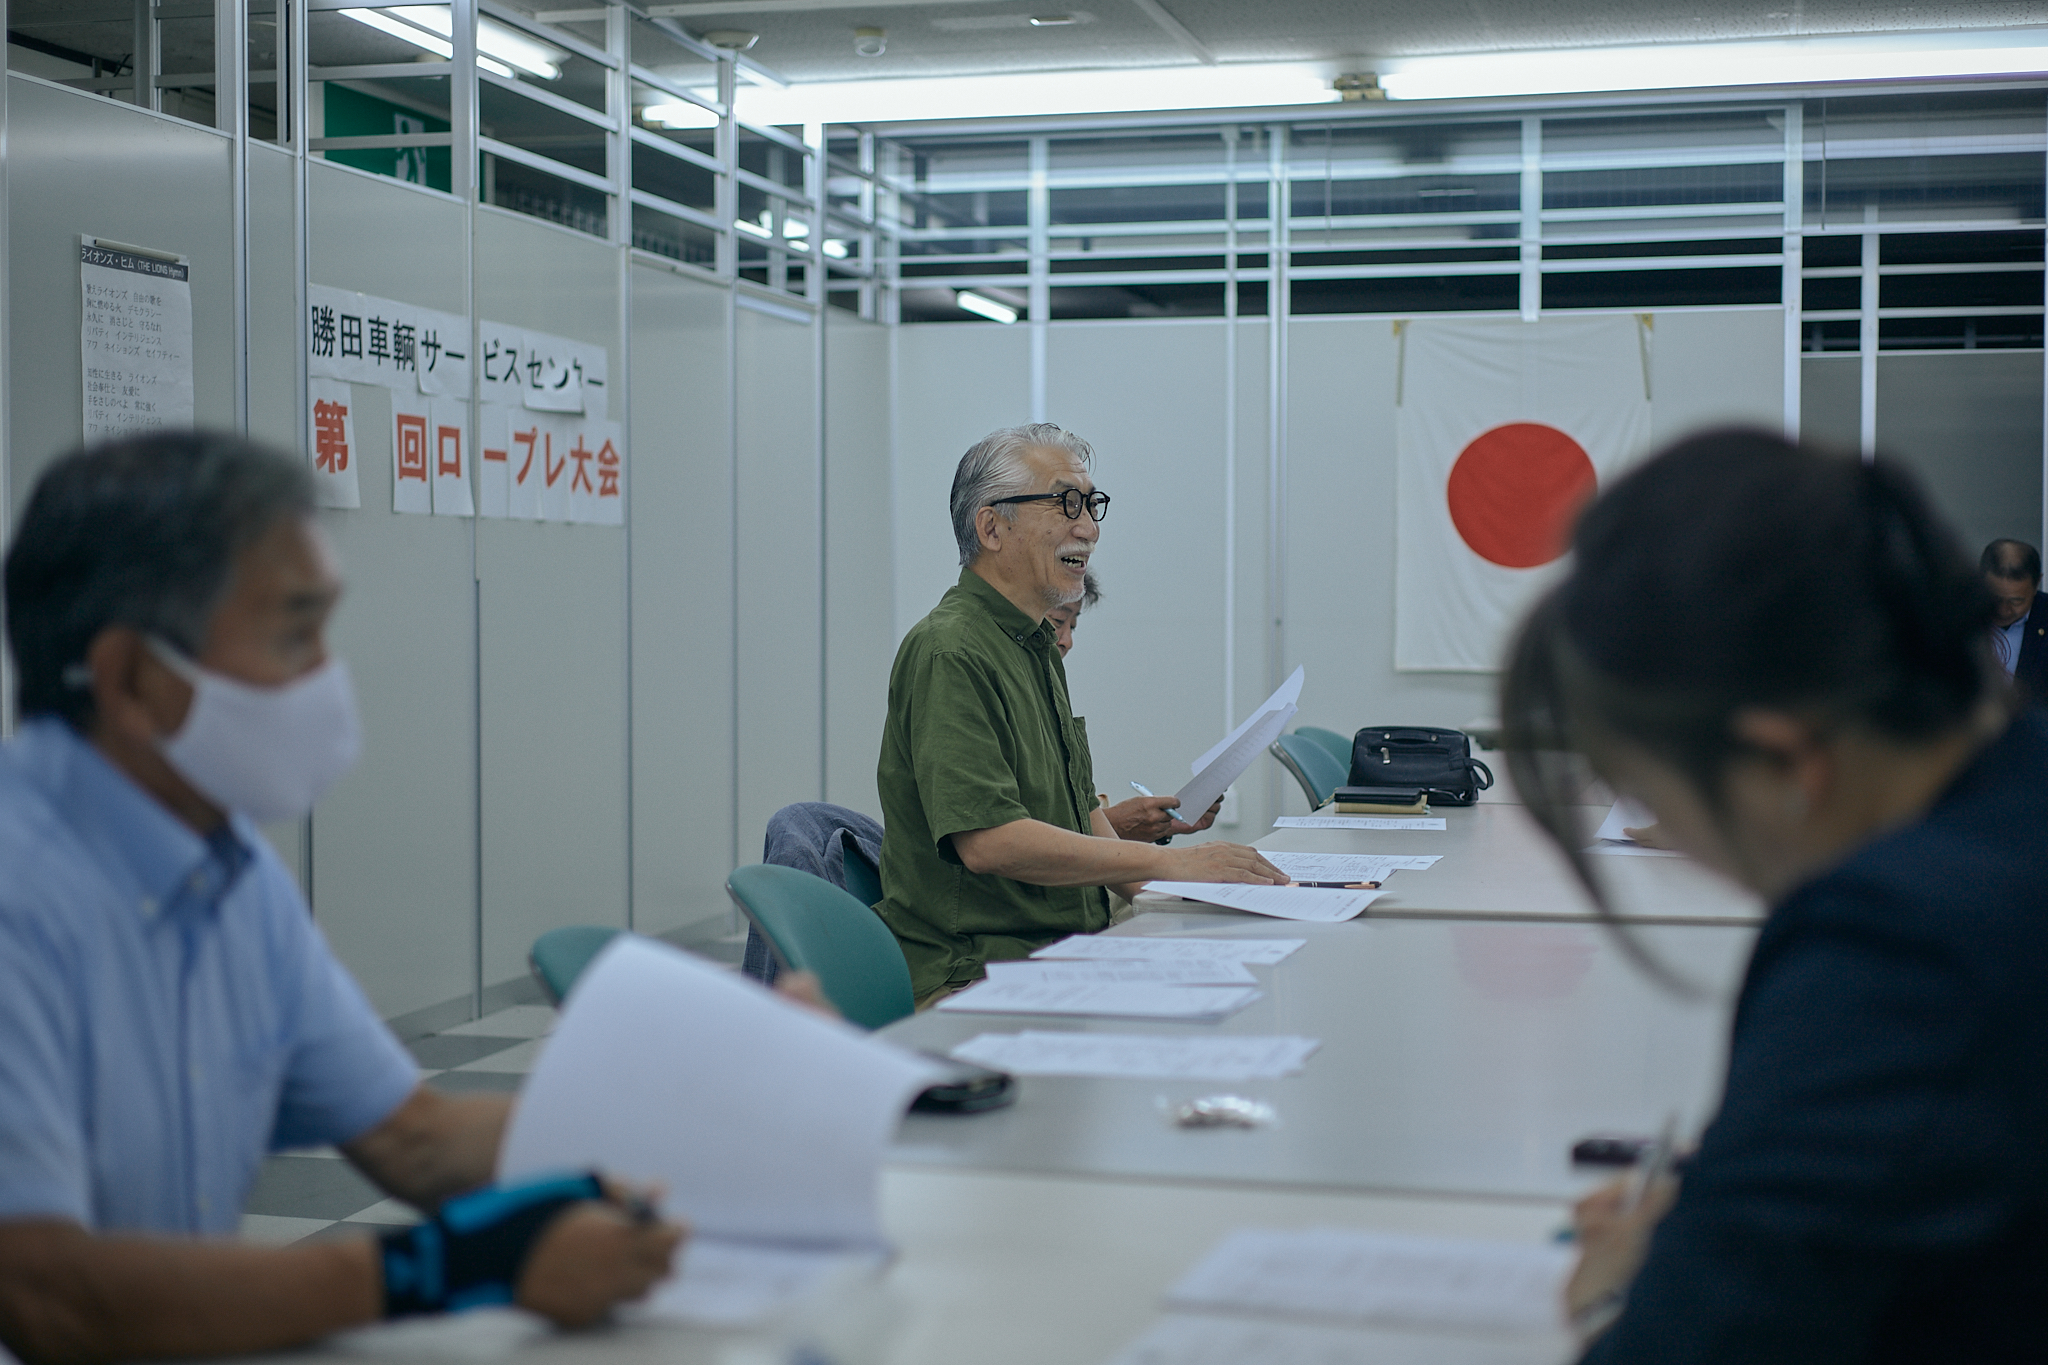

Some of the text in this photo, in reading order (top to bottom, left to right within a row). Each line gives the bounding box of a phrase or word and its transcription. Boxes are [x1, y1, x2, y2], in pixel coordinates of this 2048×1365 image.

[151, 265, 168, 275] LIONS
[127, 304, 162, 318] デモクラシー
[115, 331, 162, 346] インテリジェンス
[104, 342, 140, 356] ネイションズ
[146, 350, 180, 361] セイフティー
[128, 373, 158, 385] ライオンズ
